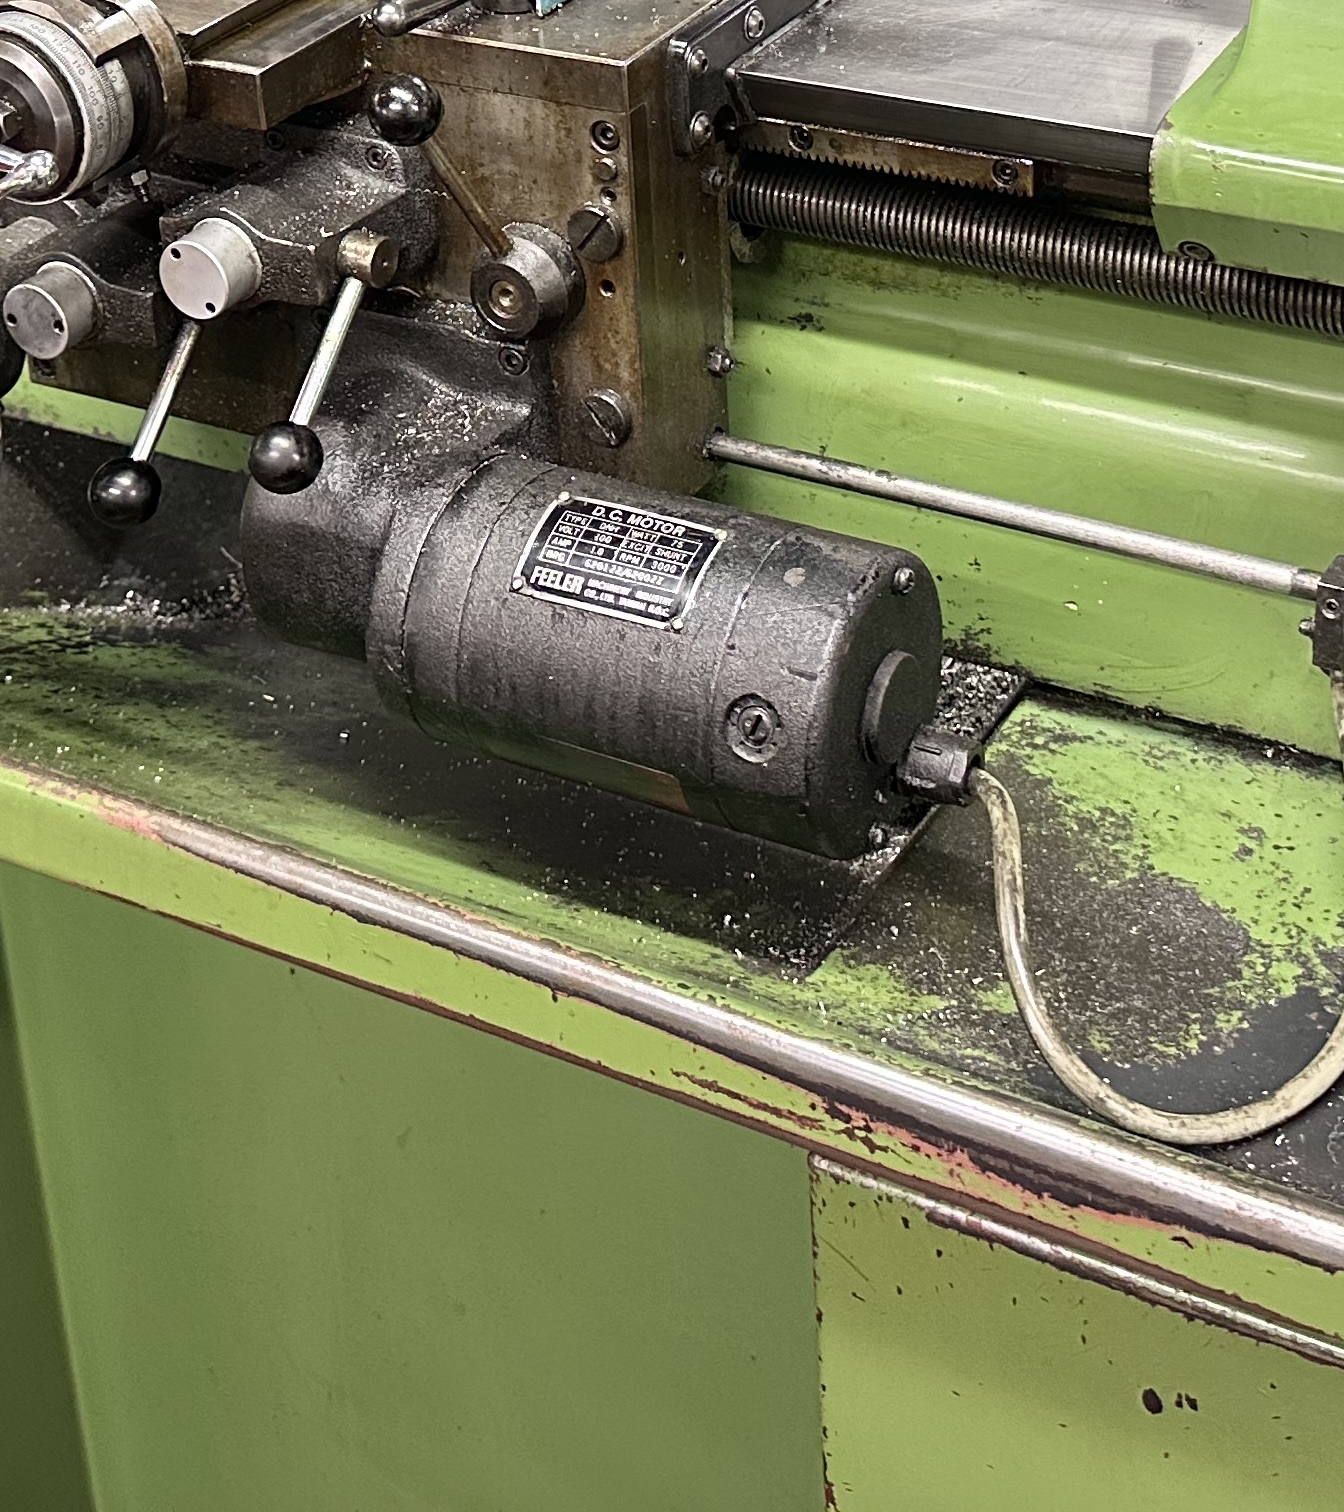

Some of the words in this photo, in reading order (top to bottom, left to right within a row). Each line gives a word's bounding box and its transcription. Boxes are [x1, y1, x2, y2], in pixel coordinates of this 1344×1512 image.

[626, 513, 686, 538] MOTOR
[550, 536, 573, 549] AMP
[618, 551, 642, 566] RPM
[650, 559, 678, 574] 3000
[557, 524, 581, 537] VOLT
[621, 539, 651, 554] EXCIT
[654, 547, 688, 563] SHUNT
[529, 564, 586, 595] FEELER
